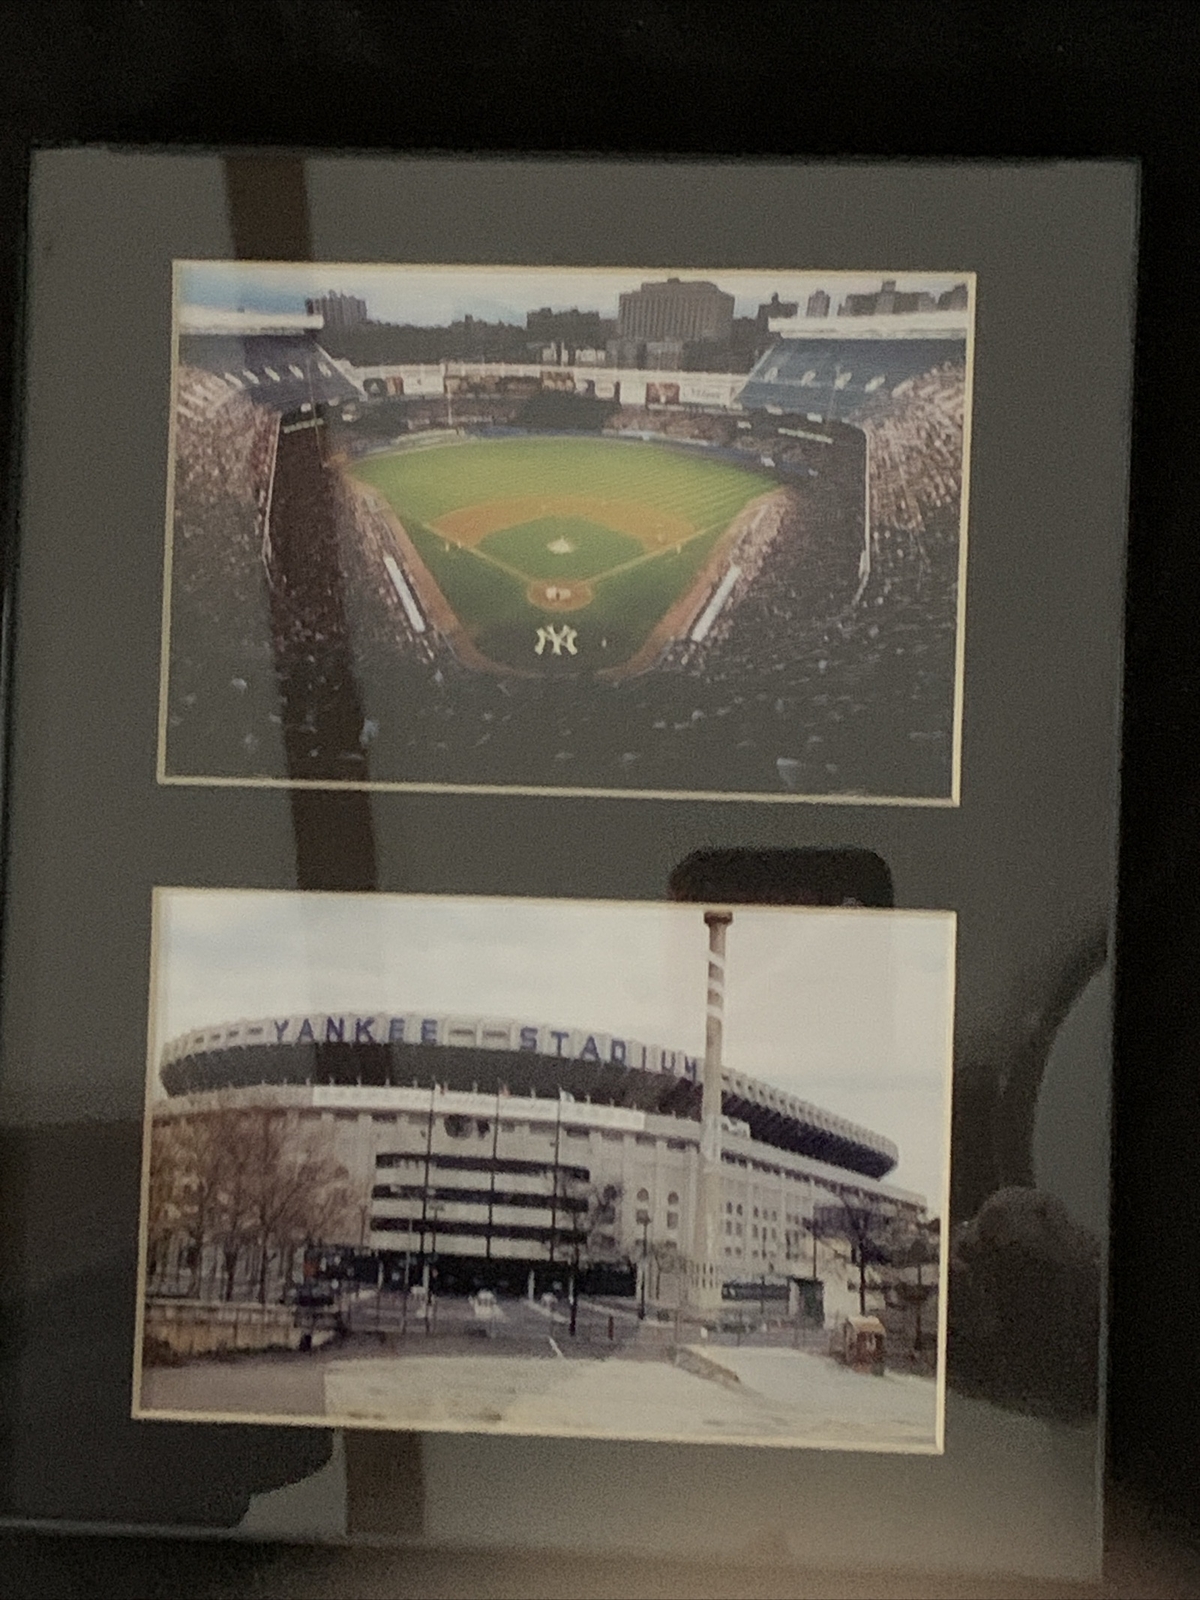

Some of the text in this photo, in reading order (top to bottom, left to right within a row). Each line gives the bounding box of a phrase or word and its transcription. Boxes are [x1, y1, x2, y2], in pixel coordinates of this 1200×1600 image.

[535, 624, 578, 655] NY
[274, 1017, 697, 1083] YANKEE STADIUM
